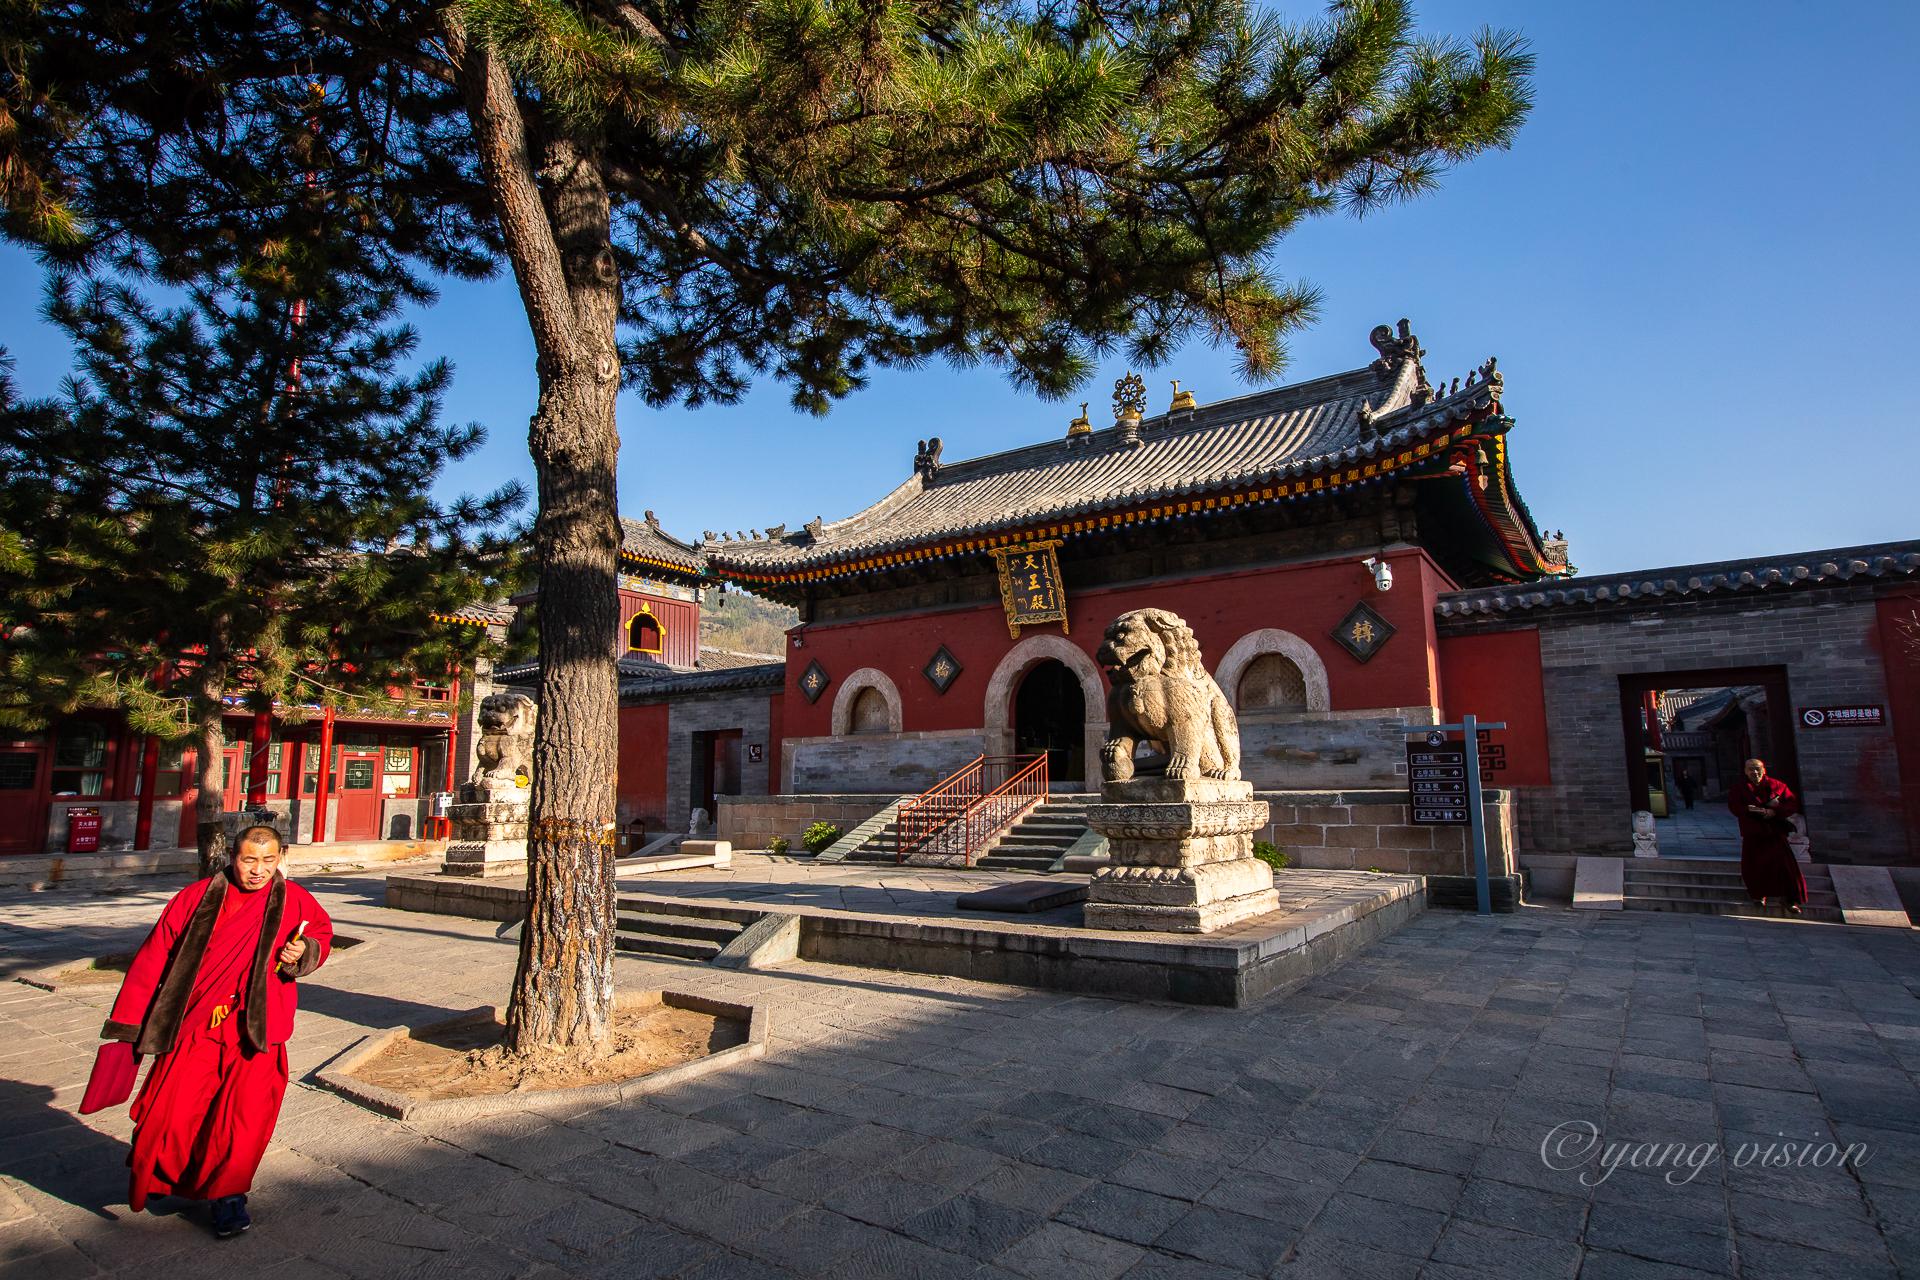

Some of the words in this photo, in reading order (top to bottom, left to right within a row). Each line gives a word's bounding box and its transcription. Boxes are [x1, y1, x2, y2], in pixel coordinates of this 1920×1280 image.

[1024, 554, 1048, 610] 天王殿
[1352, 620, 1374, 643] 轉
[808, 673, 819, 688] 法
